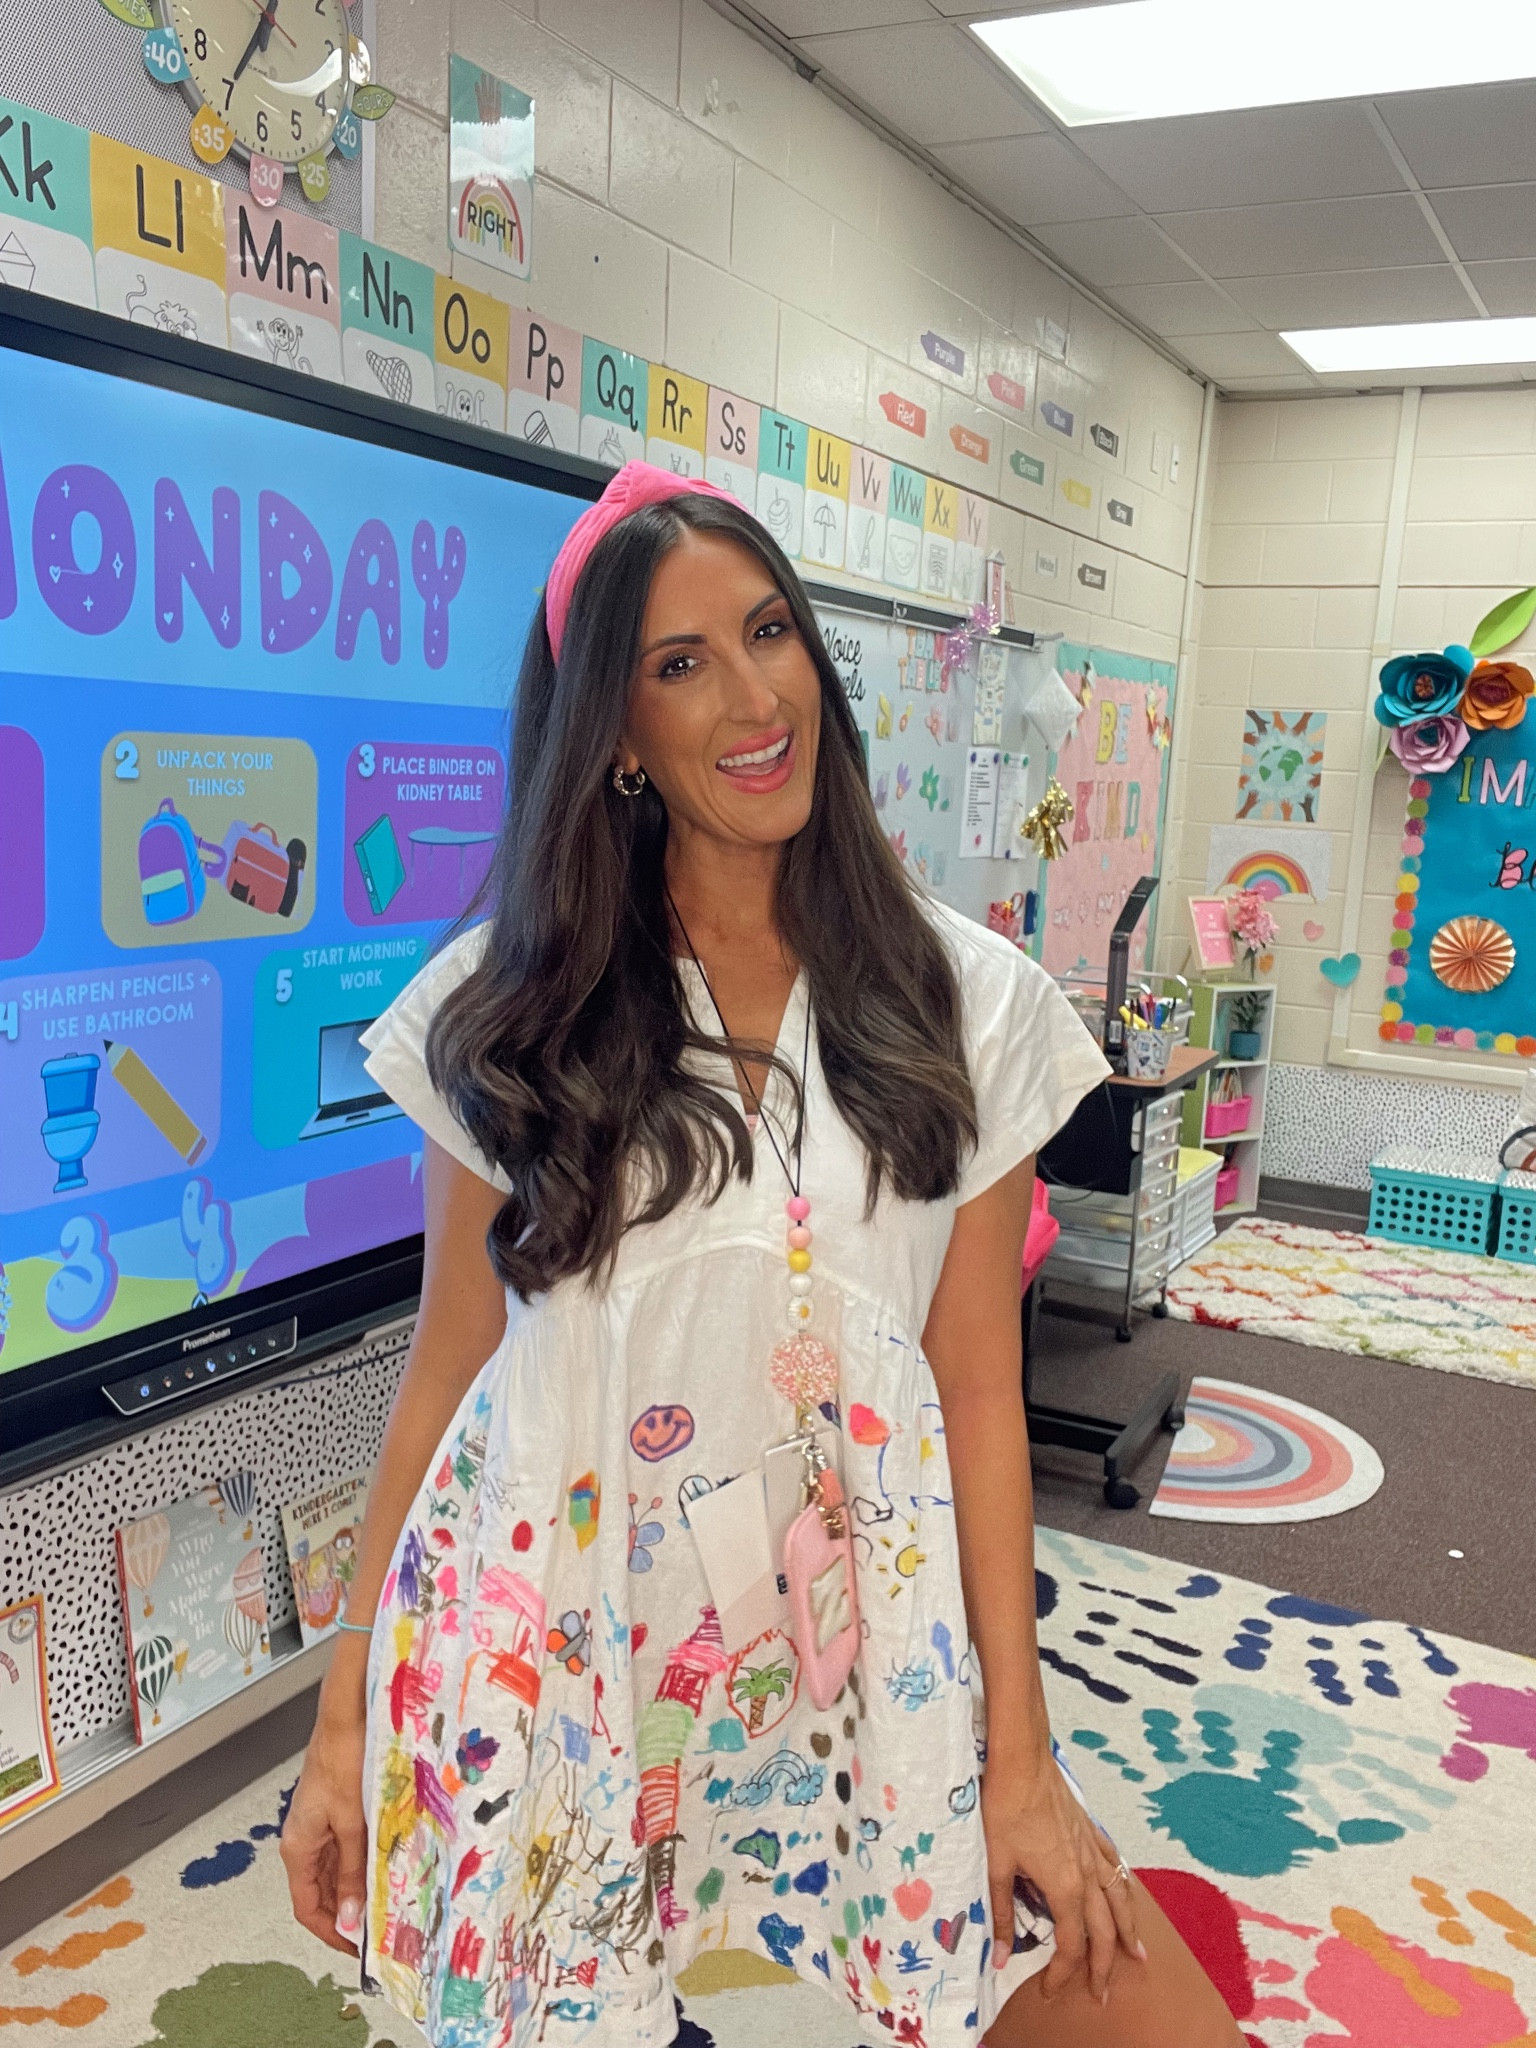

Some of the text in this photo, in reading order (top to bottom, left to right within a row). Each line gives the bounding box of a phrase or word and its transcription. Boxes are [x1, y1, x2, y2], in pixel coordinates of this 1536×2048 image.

[145, 42, 181, 74] :40
[194, 28, 208, 61] 8
[222, 78, 235, 111] 7
[315, 91, 327, 117] 4
[194, 123, 225, 152] :35
[256, 111, 268, 142] 6
[290, 109, 302, 141] 5
[336, 114, 358, 149] :20
[253, 163, 281, 190] :30
[302, 162, 326, 186] :25
[467, 200, 517, 242] RIGHT
[136, 164, 184, 253] Ll
[239, 205, 328, 304] Mm
[363, 251, 414, 334] Nn
[444, 292, 491, 364] Oo
[527, 322, 565, 401] Pp
[597, 354, 639, 432] Qq
[662, 378, 692, 434] Rr
[720, 401, 746, 456] Ss
[774, 420, 795, 471] Tt
[816, 438, 840, 489] Uu
[861, 456, 881, 502] Vv
[893, 469, 922, 519] Ww
[932, 486, 951, 530] Xx
[966, 497, 982, 547] Yy
[934, 341, 956, 366] Purple
[897, 402, 915, 428] Red
[1019, 456, 1040, 478] Green
[0, 446, 467, 670] ONDAY
[824, 626, 863, 665] Voice
[1095, 699, 1133, 765] BE
[115, 739, 140, 779] 2
[157, 748, 274, 771] UNPACK YOUR
[357, 743, 377, 778] 3
[382, 755, 496, 777] PLACE BINDER ON
[187, 777, 247, 797] THINGS
[396, 783, 483, 801] KIDNEY TABLE
[303, 939, 418, 969] START MORNING
[21, 980, 115, 1012] SHARPEN
[121, 972, 195, 999] PENCILS
[276, 968, 293, 1003] 5
[340, 968, 383, 990] WORK
[42, 1001, 194, 1041] USE BATHROOM
[182, 1327, 231, 1352] Promethean
